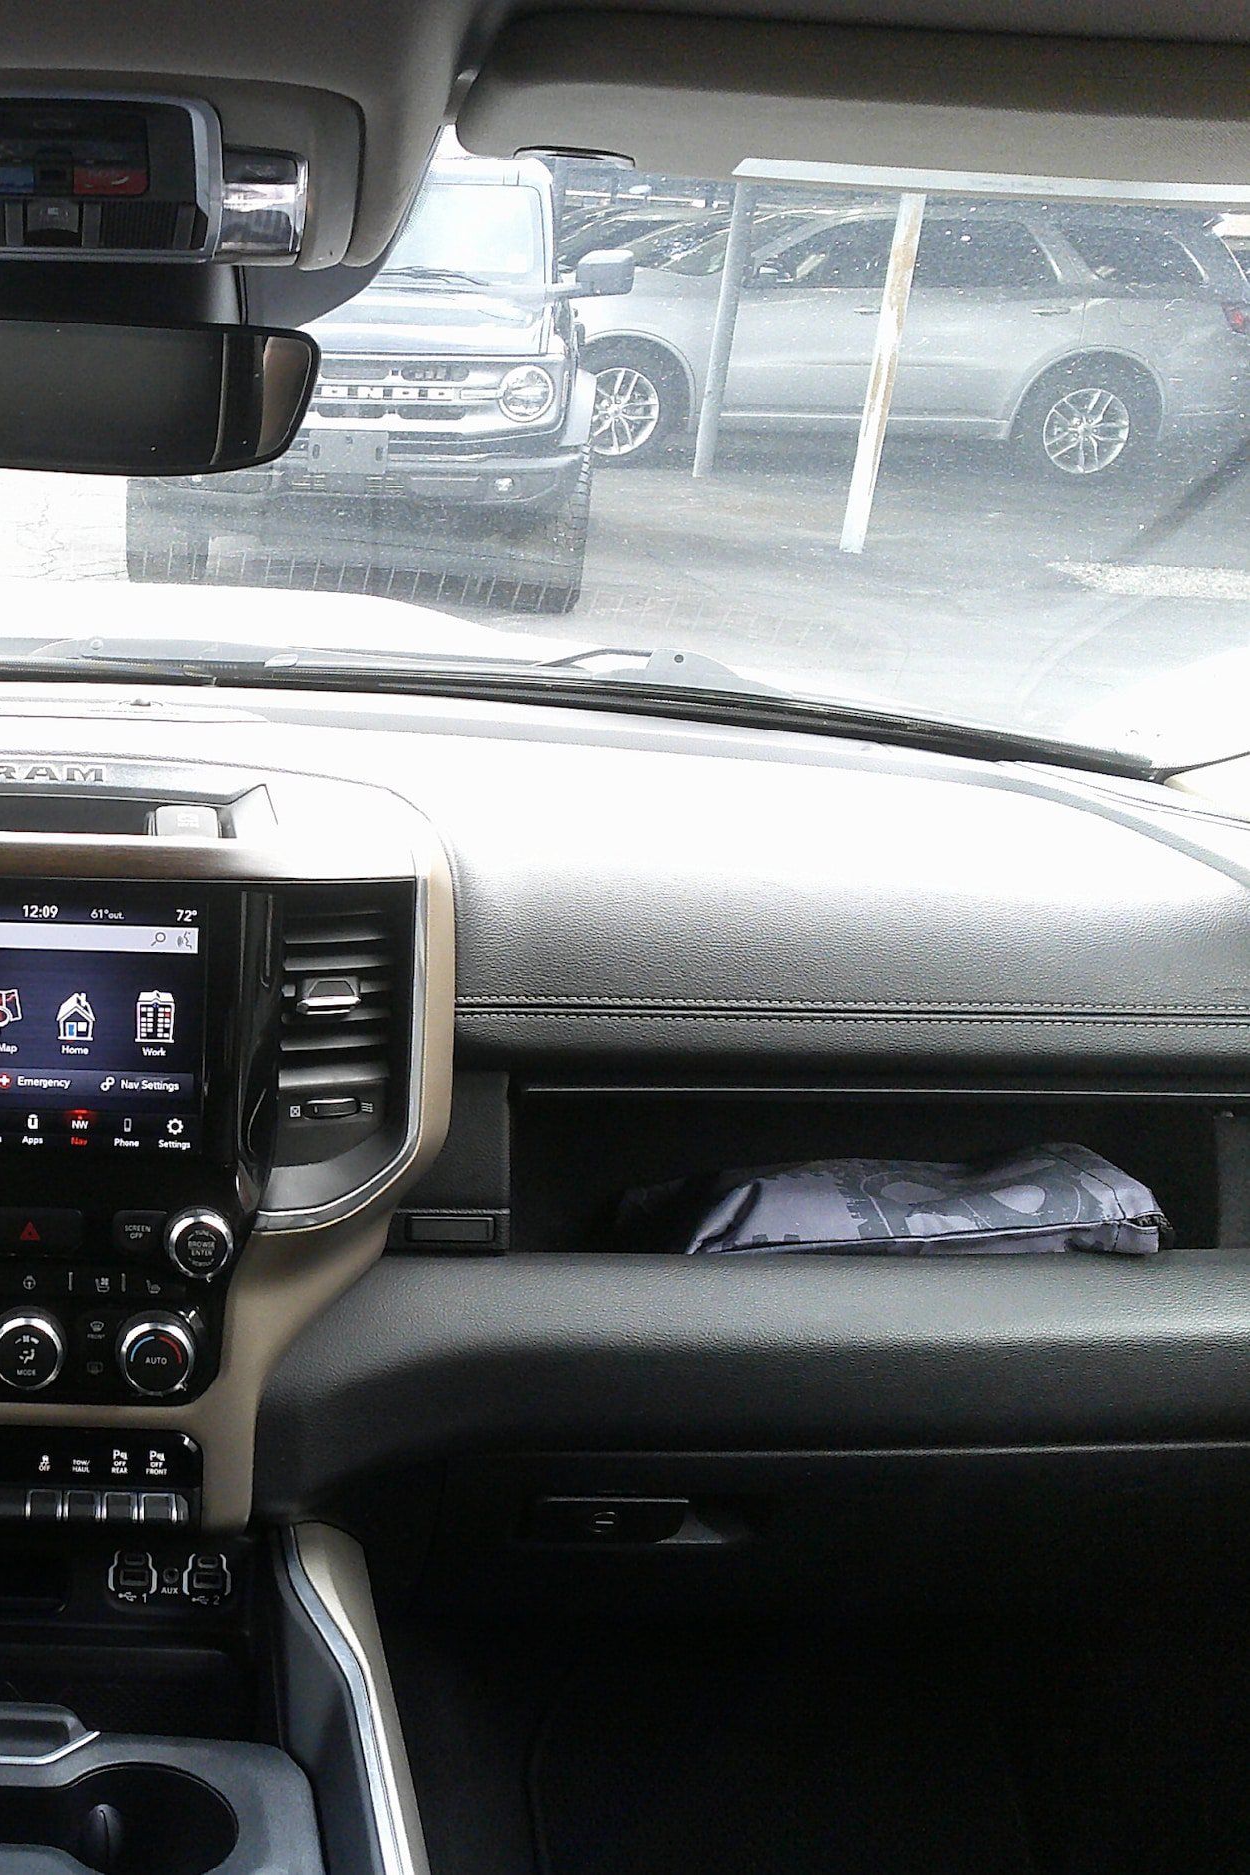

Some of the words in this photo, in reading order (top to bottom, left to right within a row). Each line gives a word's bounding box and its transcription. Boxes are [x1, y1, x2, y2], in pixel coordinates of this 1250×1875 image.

[22, 905, 59, 918] 12:09
[61, 1044, 89, 1055] Home
[142, 1046, 166, 1057] Work
[17, 1076, 71, 1090] Emergency
[120, 1079, 140, 1090] Nav
[141, 1080, 179, 1092] Settings
[71, 1120, 89, 1130] NW
[21, 1136, 43, 1145] Apps
[70, 1136, 88, 1146] Nav
[114, 1137, 140, 1147] Phone
[158, 1139, 191, 1150] Settings
[124, 1224, 151, 1233] SCREEN
[130, 1232, 143, 1240] OFF
[145, 1356, 168, 1365] AUTO
[145, 1468, 167, 1476] FRONT
[160, 1586, 178, 1595] AUX
[141, 1593, 147, 1604] 1
[213, 1595, 220, 1606] 2
